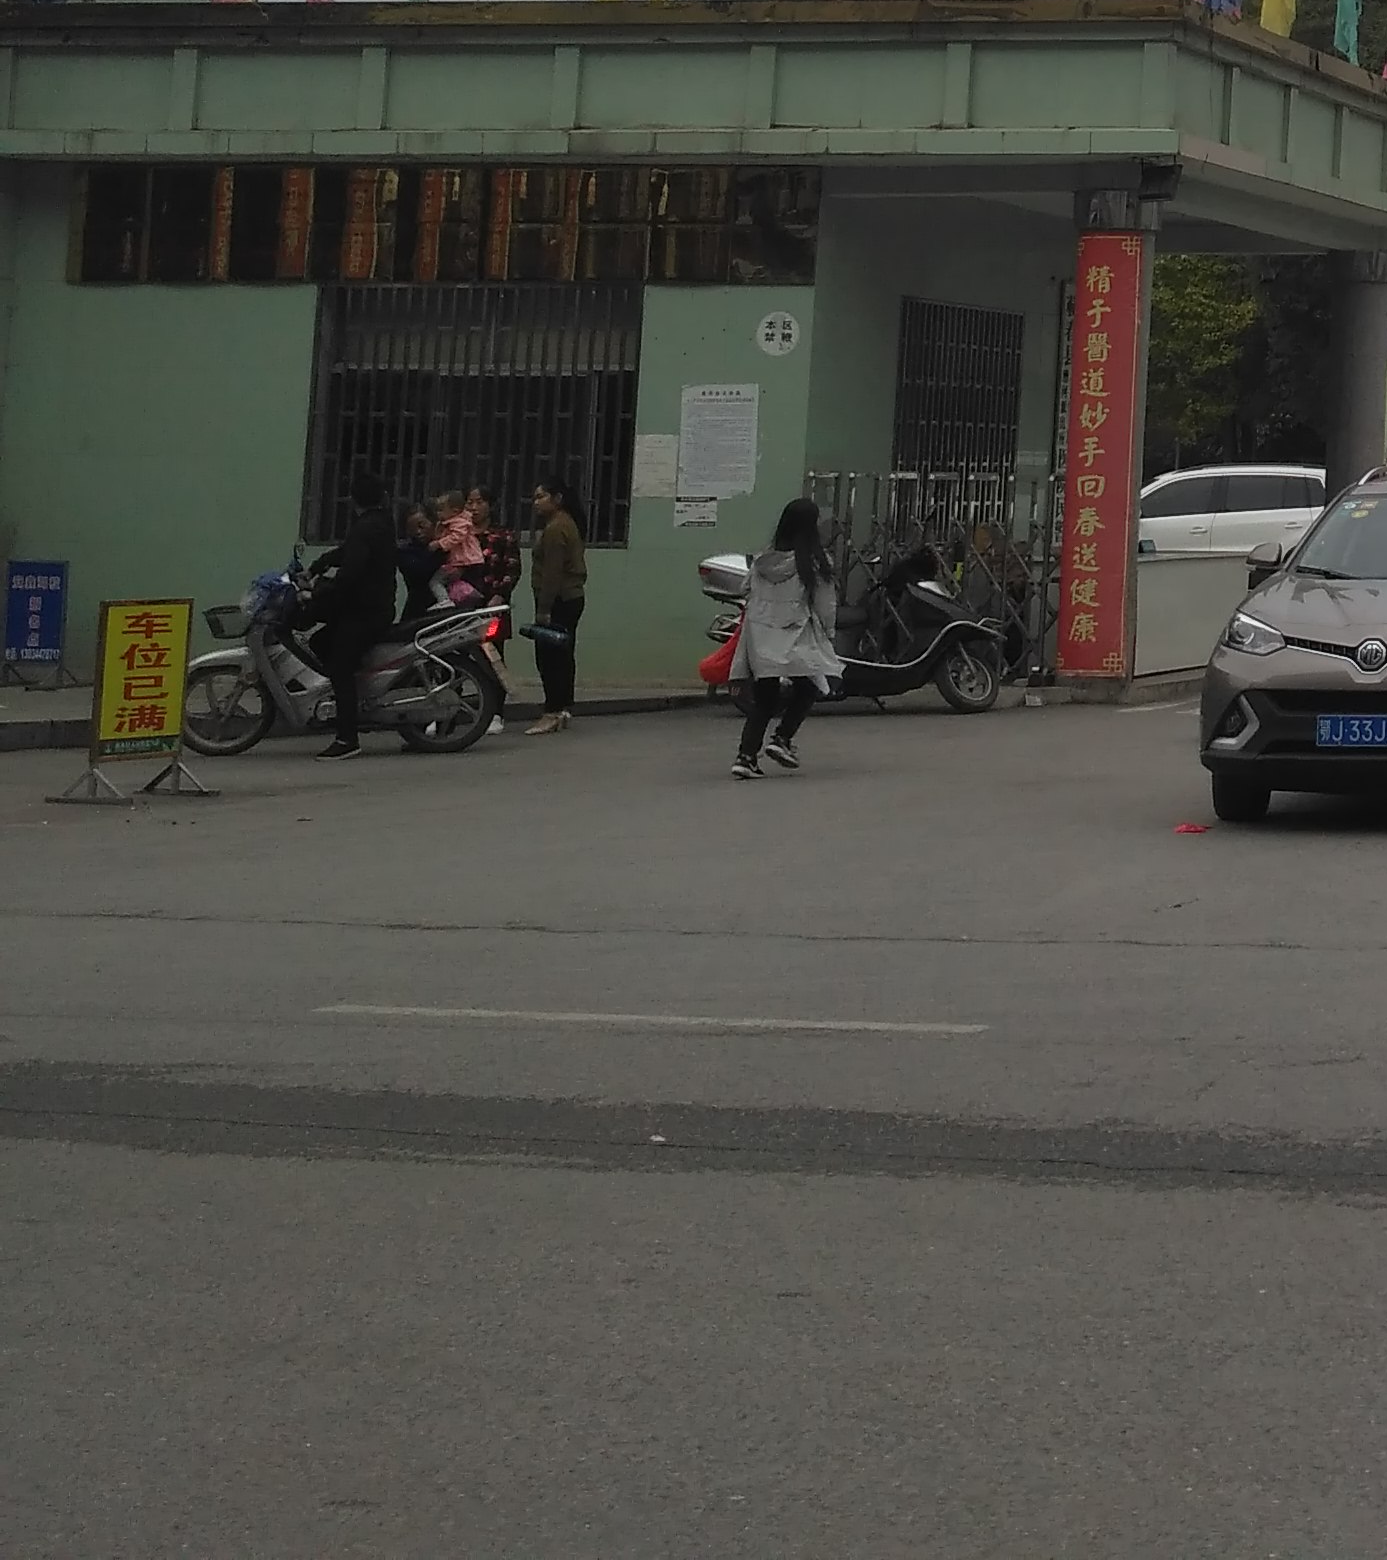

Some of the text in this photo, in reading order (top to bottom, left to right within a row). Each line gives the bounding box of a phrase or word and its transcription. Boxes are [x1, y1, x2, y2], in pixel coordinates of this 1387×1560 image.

[114, 611, 173, 733] 车位已满
[1360, 644, 1384, 665] MG
